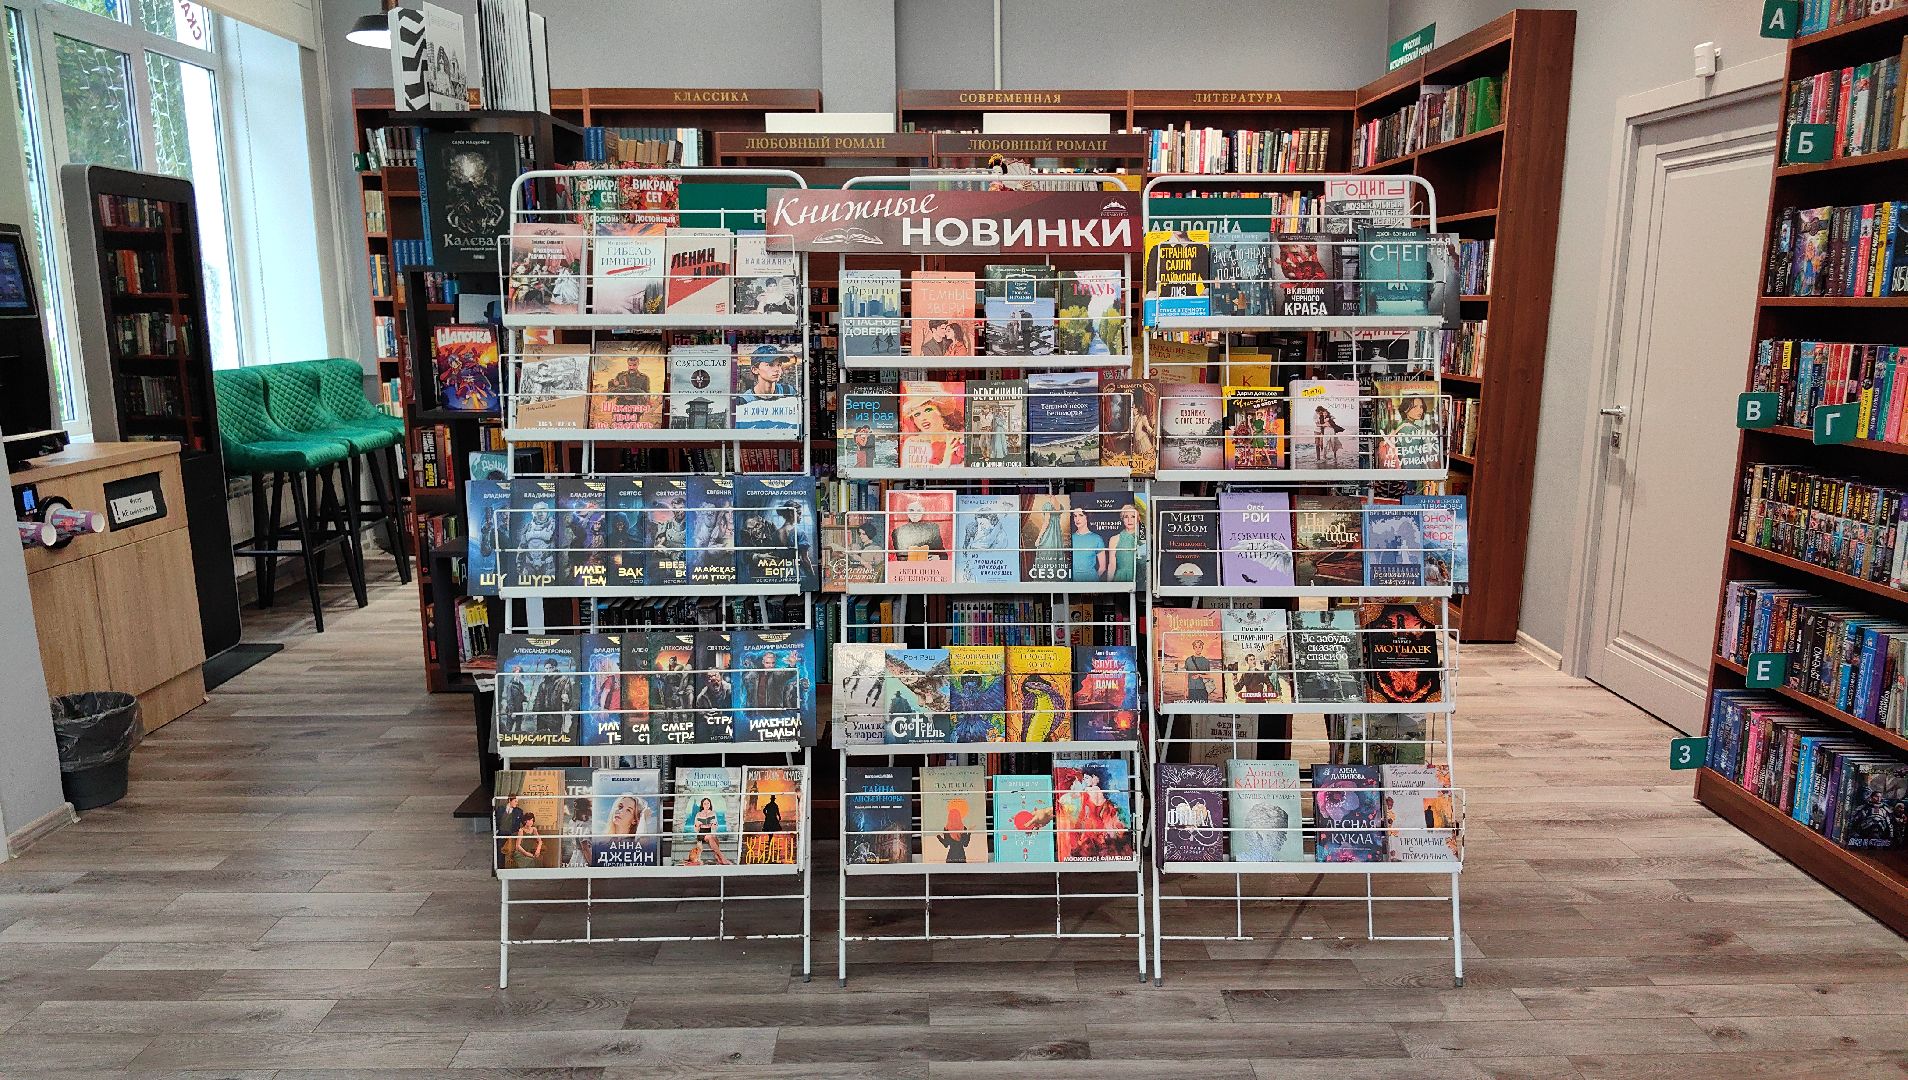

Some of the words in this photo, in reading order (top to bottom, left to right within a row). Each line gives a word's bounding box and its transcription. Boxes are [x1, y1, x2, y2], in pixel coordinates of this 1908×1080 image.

[1768, 7, 1785, 30] А
[673, 91, 749, 102] КЛАССИКА
[959, 93, 1062, 104] СОВРЕМЕННАЯ
[1192, 93, 1283, 103] ЛИТЕРАТУРА
[746, 136, 831, 150] ЛЮБОВНЫЙ
[834, 138, 887, 149] РОМАН
[968, 137, 1053, 151] ЛЮБОВНЫЙ
[1056, 139, 1108, 151] РОМАН
[1797, 131, 1814, 154] Б
[632, 178, 675, 191] ВИКРАМ
[645, 192, 662, 203] СЕТ
[773, 193, 940, 228] Книжные
[1188, 218, 1242, 232] ПОЛКА
[902, 217, 1132, 247] НОВИНКИ
[671, 248, 715, 269] ЛЕНИН
[1160, 247, 1197, 259] СТРАННАЯ
[1370, 244, 1424, 262] СНЕГ
[1165, 260, 1191, 270] САЛЛИ
[1284, 302, 1328, 316] КРАБА
[844, 327, 898, 337] ДОВЕРИЕ
[675, 359, 727, 367] СВЯТОСЛАВ
[751, 406, 769, 416] ХОЧУ
[772, 406, 796, 416] ЖИТЬ!
[1745, 400, 1761, 421] В
[872, 412, 894, 422] рая
[1825, 412, 1841, 436] Г
[1387, 443, 1439, 457] ДЕВОЧЕК
[1384, 459, 1396, 468] НЕ
[1398, 454, 1439, 466] УБИВАЮТ
[1170, 512, 1204, 522] Митч
[1167, 523, 1208, 533] Элбом
[1229, 532, 1286, 541] ЛОВУШКА
[1316, 633, 1351, 644] забудь
[1374, 644, 1432, 653] МОТЫЛЕК
[1306, 652, 1348, 661] спасибо
[1093, 659, 1119, 668] СЛУГА
[1756, 660, 1772, 681] Е
[1095, 680, 1118, 689] ДАМЫ
[1234, 778, 1297, 790] КАРРИЗИ
[1331, 833, 1374, 845] КУКЛА
[609, 841, 642, 850] АННА
[745, 836, 794, 864] ЖИЛЕЦ
[597, 850, 654, 864] ДЖЕЙН
